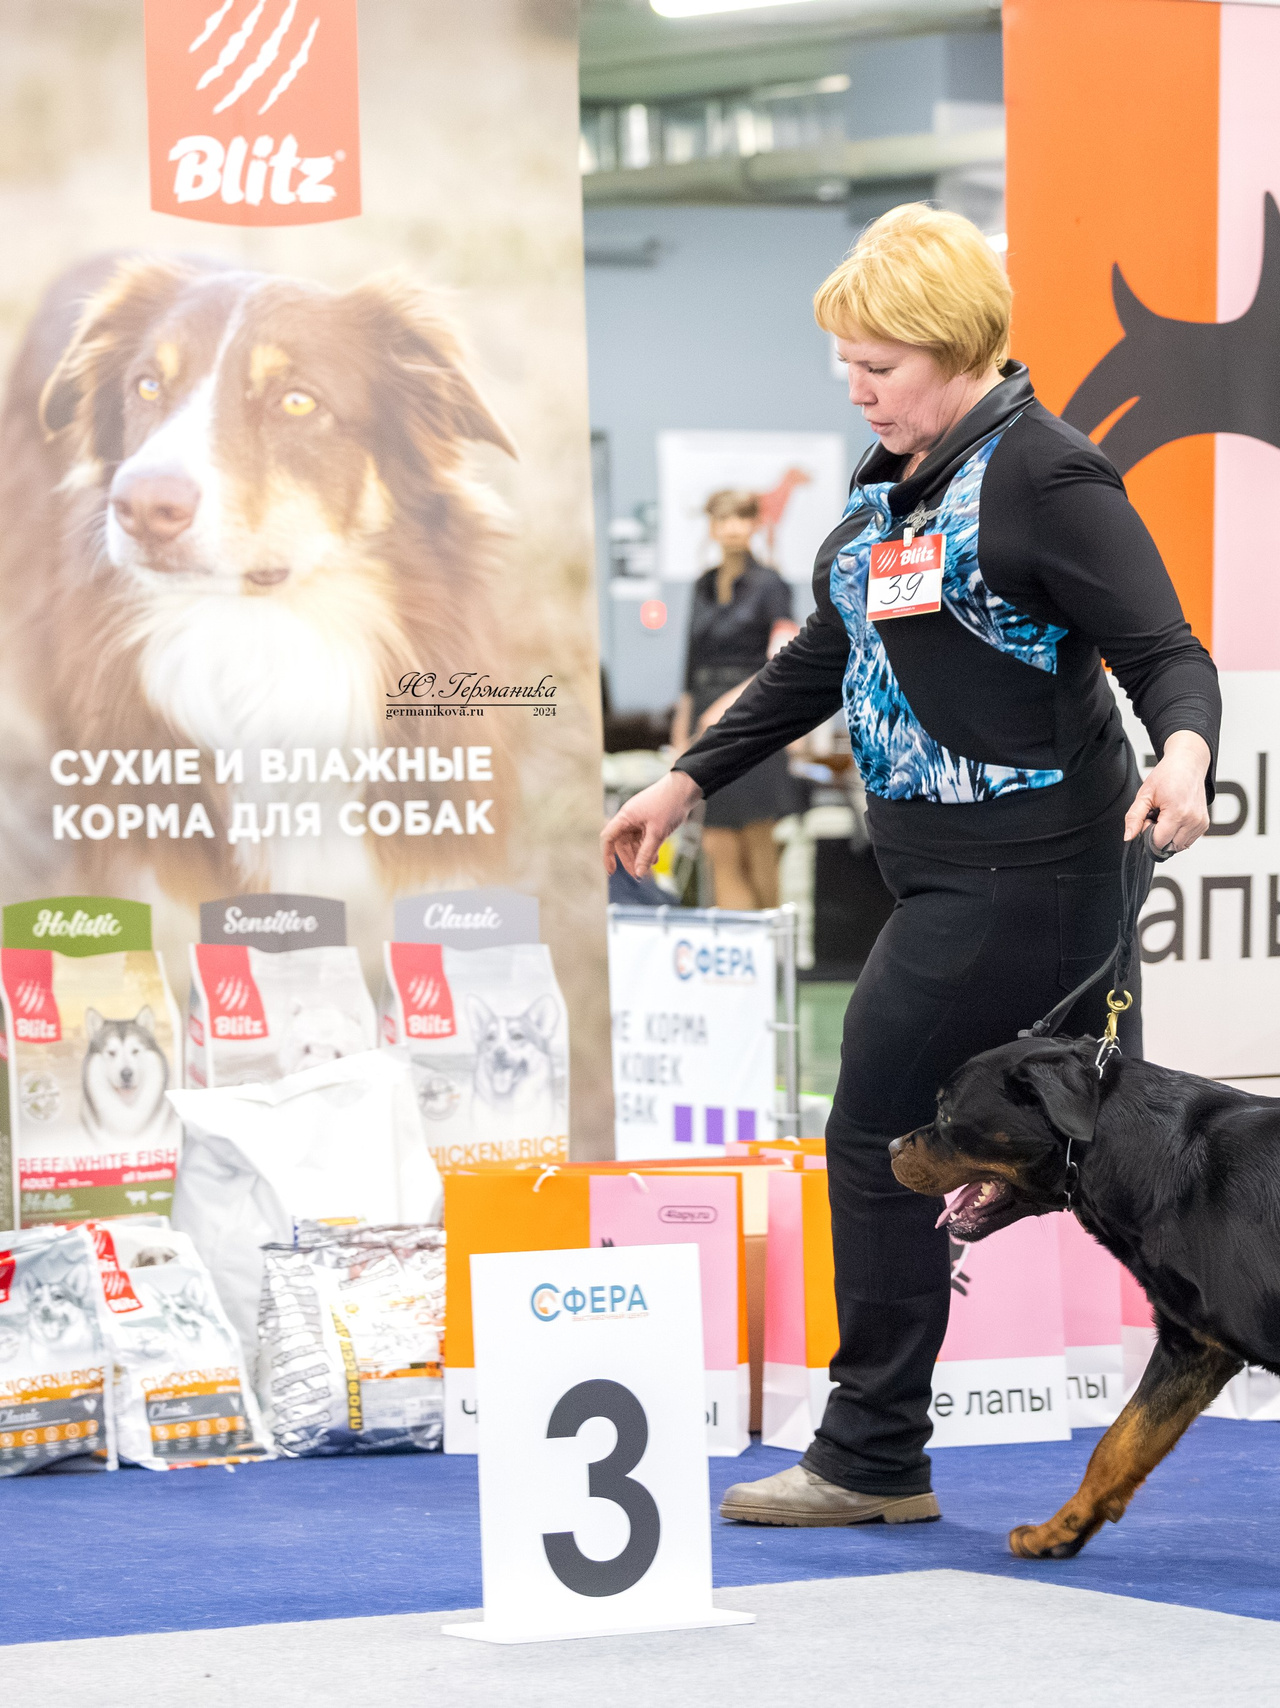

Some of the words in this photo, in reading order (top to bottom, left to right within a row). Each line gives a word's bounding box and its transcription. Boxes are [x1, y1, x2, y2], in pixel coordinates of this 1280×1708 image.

[168, 133, 337, 206] Blitz
[900, 546, 934, 566] Blitz
[880, 572, 924, 605] 39
[50, 748, 201, 786] СУХИЕ
[215, 749, 245, 784] И
[260, 746, 494, 783] ВЛАЖНЫЕ
[52, 804, 215, 840] КОРМА
[228, 802, 321, 843] ДЛЯ
[338, 800, 495, 836] СОБАК
[32, 909, 122, 938] Holistic
[223, 906, 319, 935] Sensitive
[423, 903, 502, 930] Classic
[673, 939, 757, 981] СФЕРА
[214, 1015, 264, 1036] Blitz
[428, 1135, 569, 1167] HICKEN&RICE
[531, 1283, 648, 1322] СФЕРА
[965, 1386, 1053, 1416] лапы
[1066, 1374, 1108, 1399] пы
[542, 1378, 661, 1597] 3
